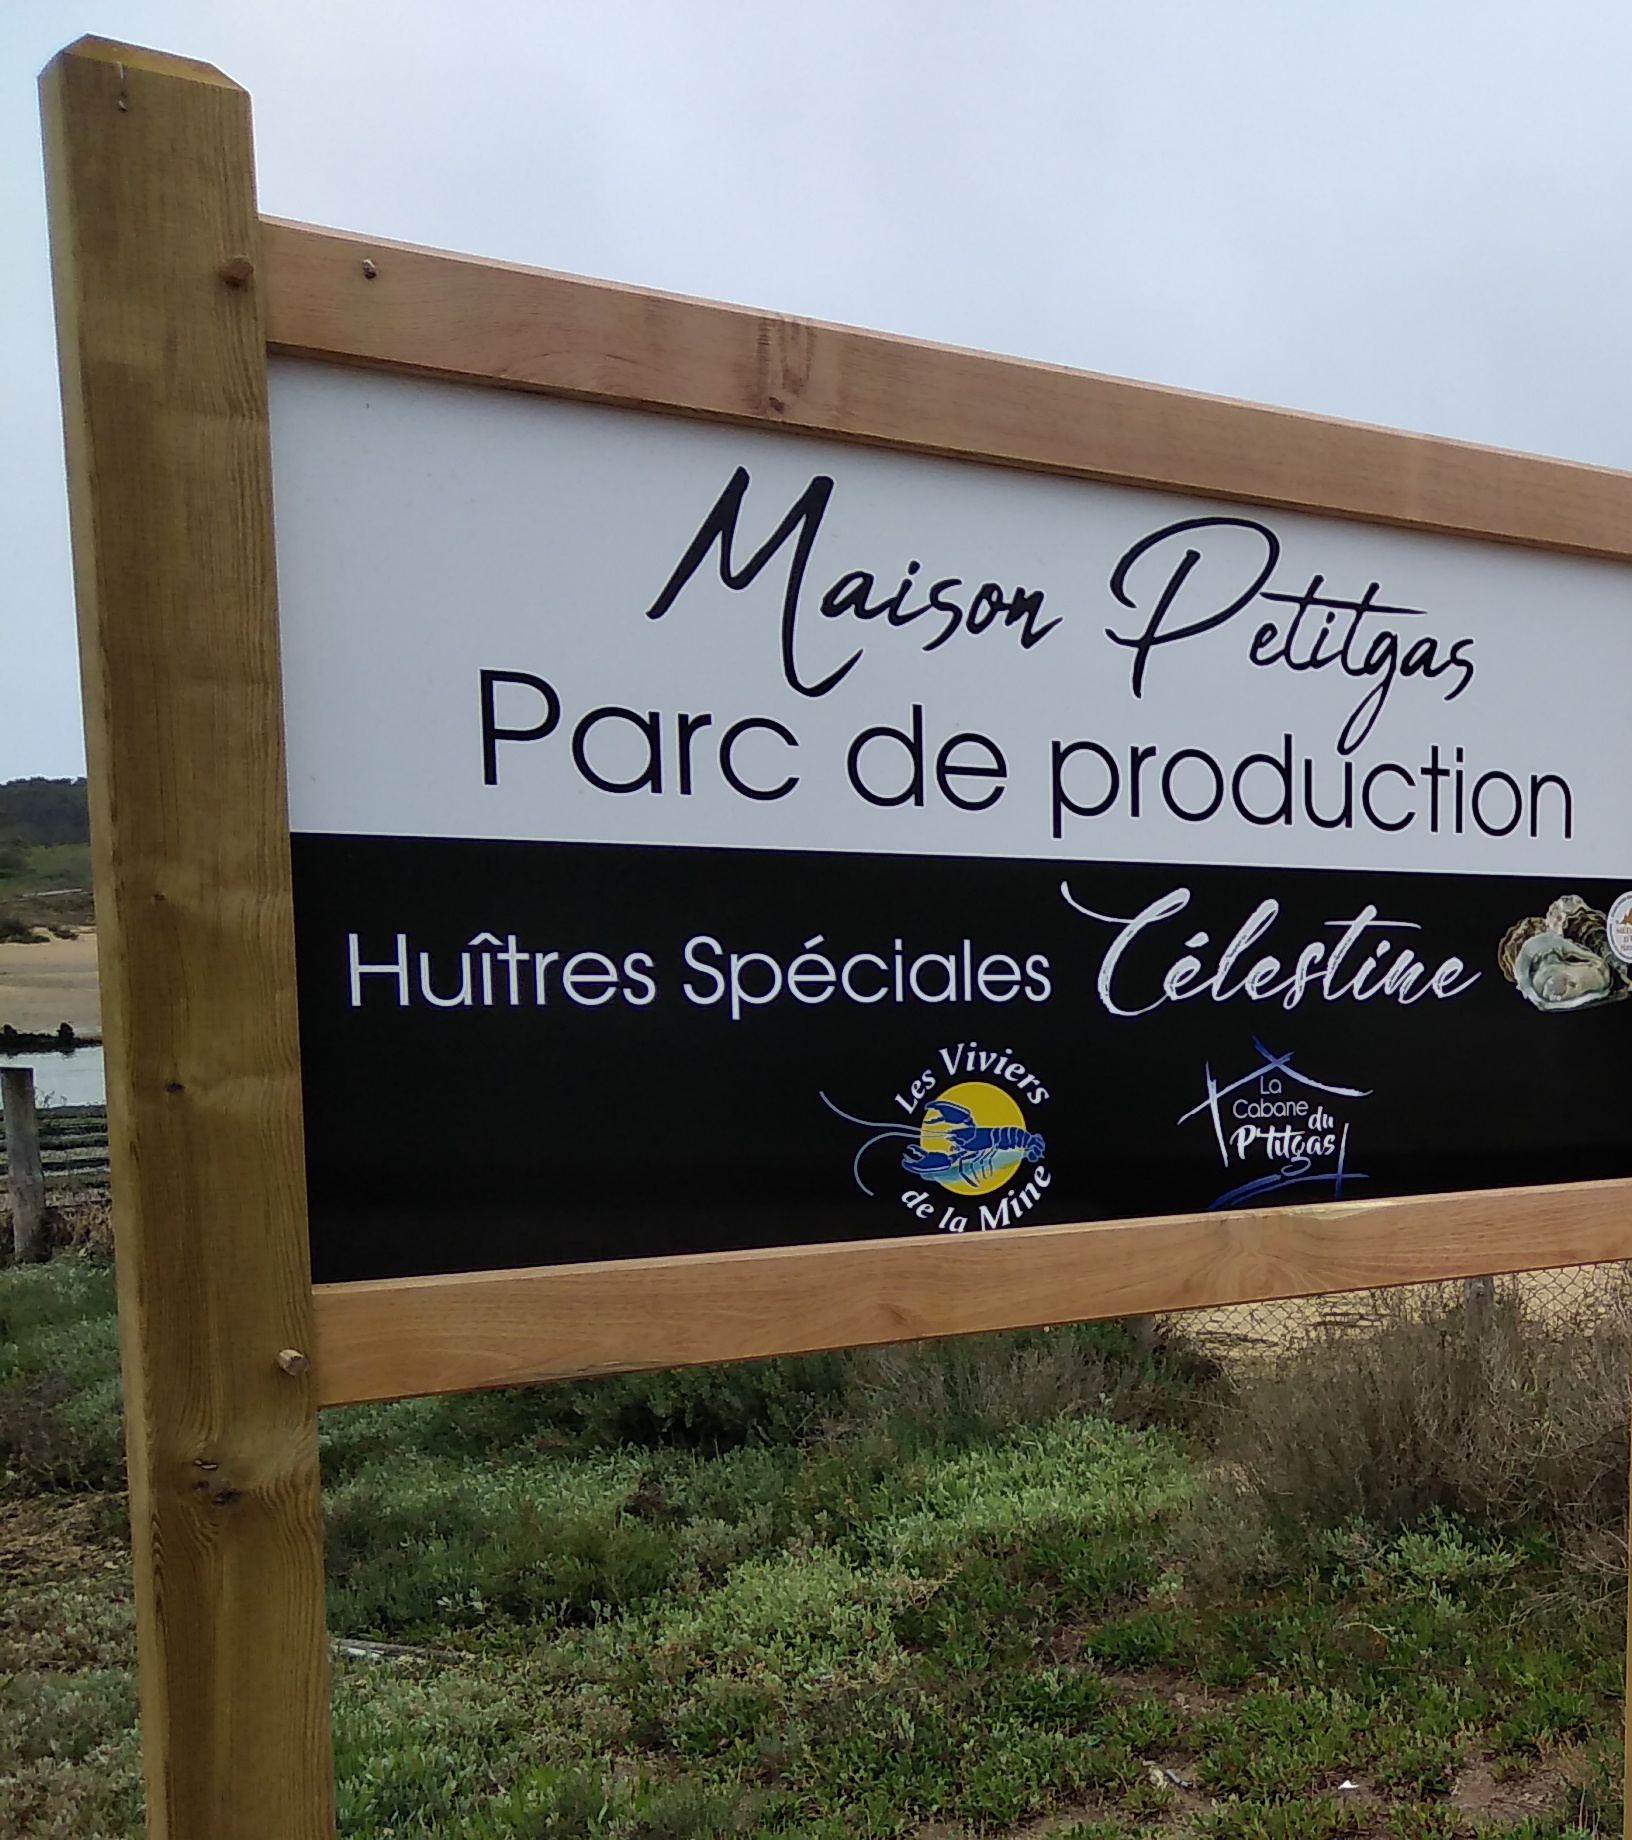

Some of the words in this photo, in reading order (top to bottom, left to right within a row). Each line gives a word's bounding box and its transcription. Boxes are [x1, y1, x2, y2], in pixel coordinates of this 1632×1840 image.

[645, 466, 1062, 697] Maison
[1105, 517, 1474, 755] Petitgas
[480, 669, 800, 800] Parc
[847, 704, 1007, 810] de
[1052, 733, 1572, 839] production
[348, 932, 656, 1007] Huîtres
[683, 934, 1052, 1020] Spéciales
[1060, 881, 1482, 1016] Célestine
[894, 1069, 937, 1115] Les
[938, 1041, 1050, 1104] Viviers
[1232, 1098, 1309, 1118] Cabane
[1260, 1075, 1282, 1095] La
[1308, 1106, 1334, 1131] du
[901, 1190, 935, 1219] de
[938, 1206, 968, 1232] la
[978, 1165, 1051, 1232] Mine
